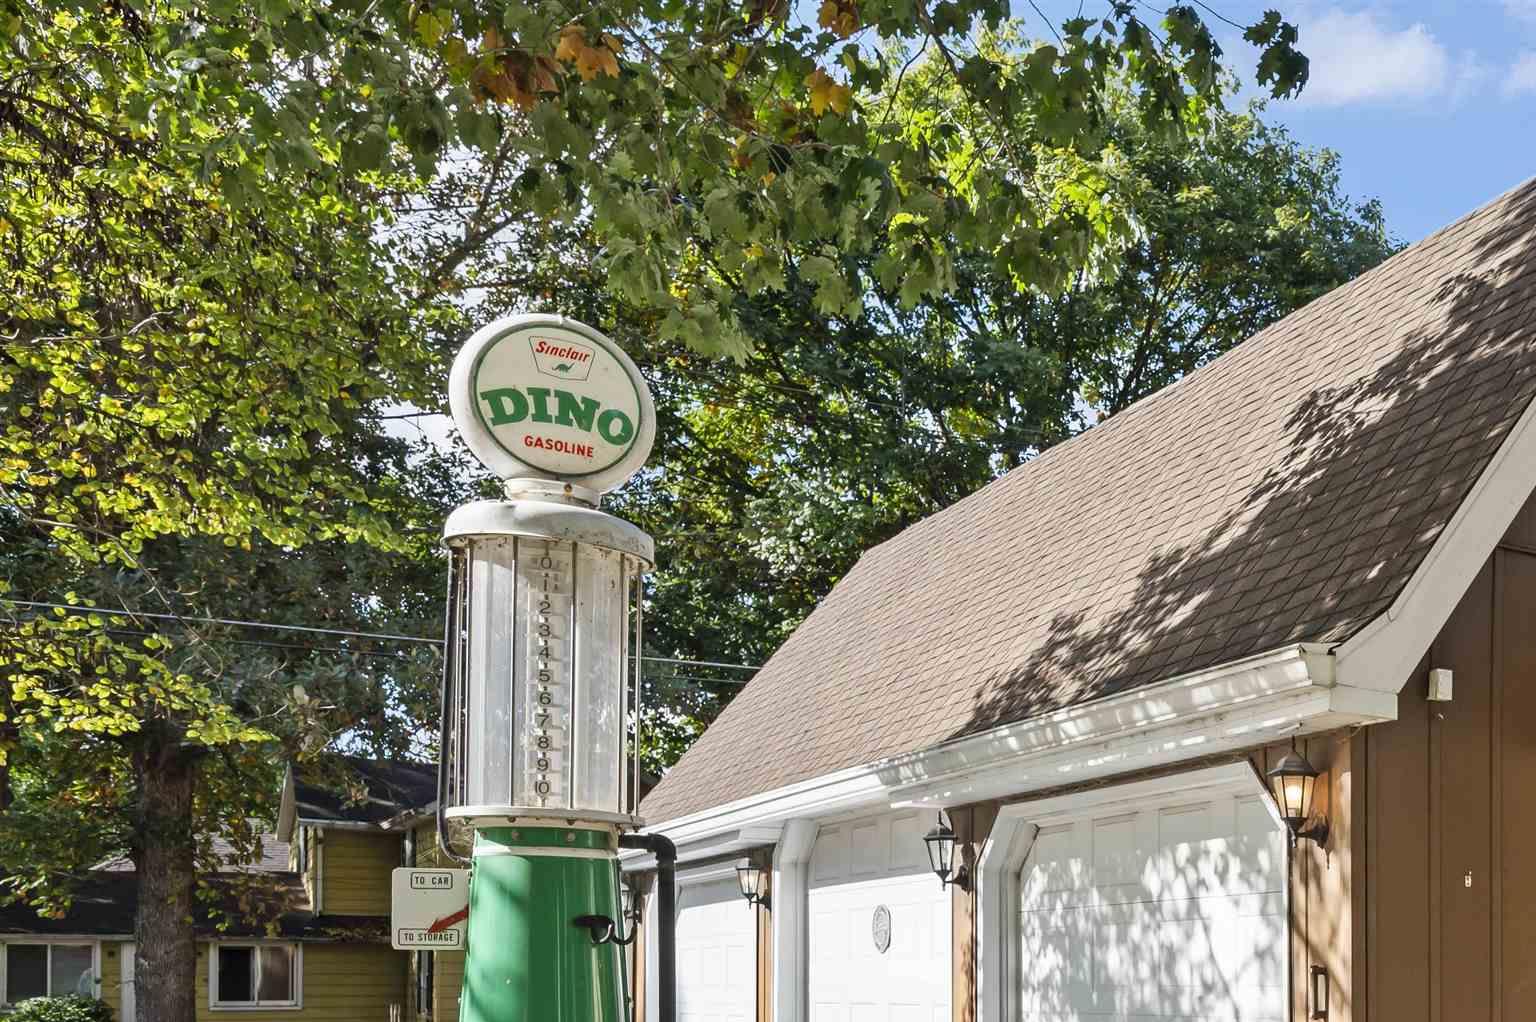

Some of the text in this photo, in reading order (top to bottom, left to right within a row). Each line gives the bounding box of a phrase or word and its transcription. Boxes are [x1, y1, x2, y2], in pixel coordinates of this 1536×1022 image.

[535, 340, 591, 363] Sinclair
[479, 387, 634, 446] DINO
[523, 435, 594, 458] GASOLINE
[539, 601, 552, 614] 2
[538, 623, 551, 637] 3
[538, 669, 551, 682] 5
[539, 691, 552, 705] 6
[537, 714, 550, 728] 7
[537, 736, 550, 749] 8
[536, 758, 549, 772] 9
[415, 876, 449, 885] TO CAR
[404, 933, 454, 942] TO STORAGE
